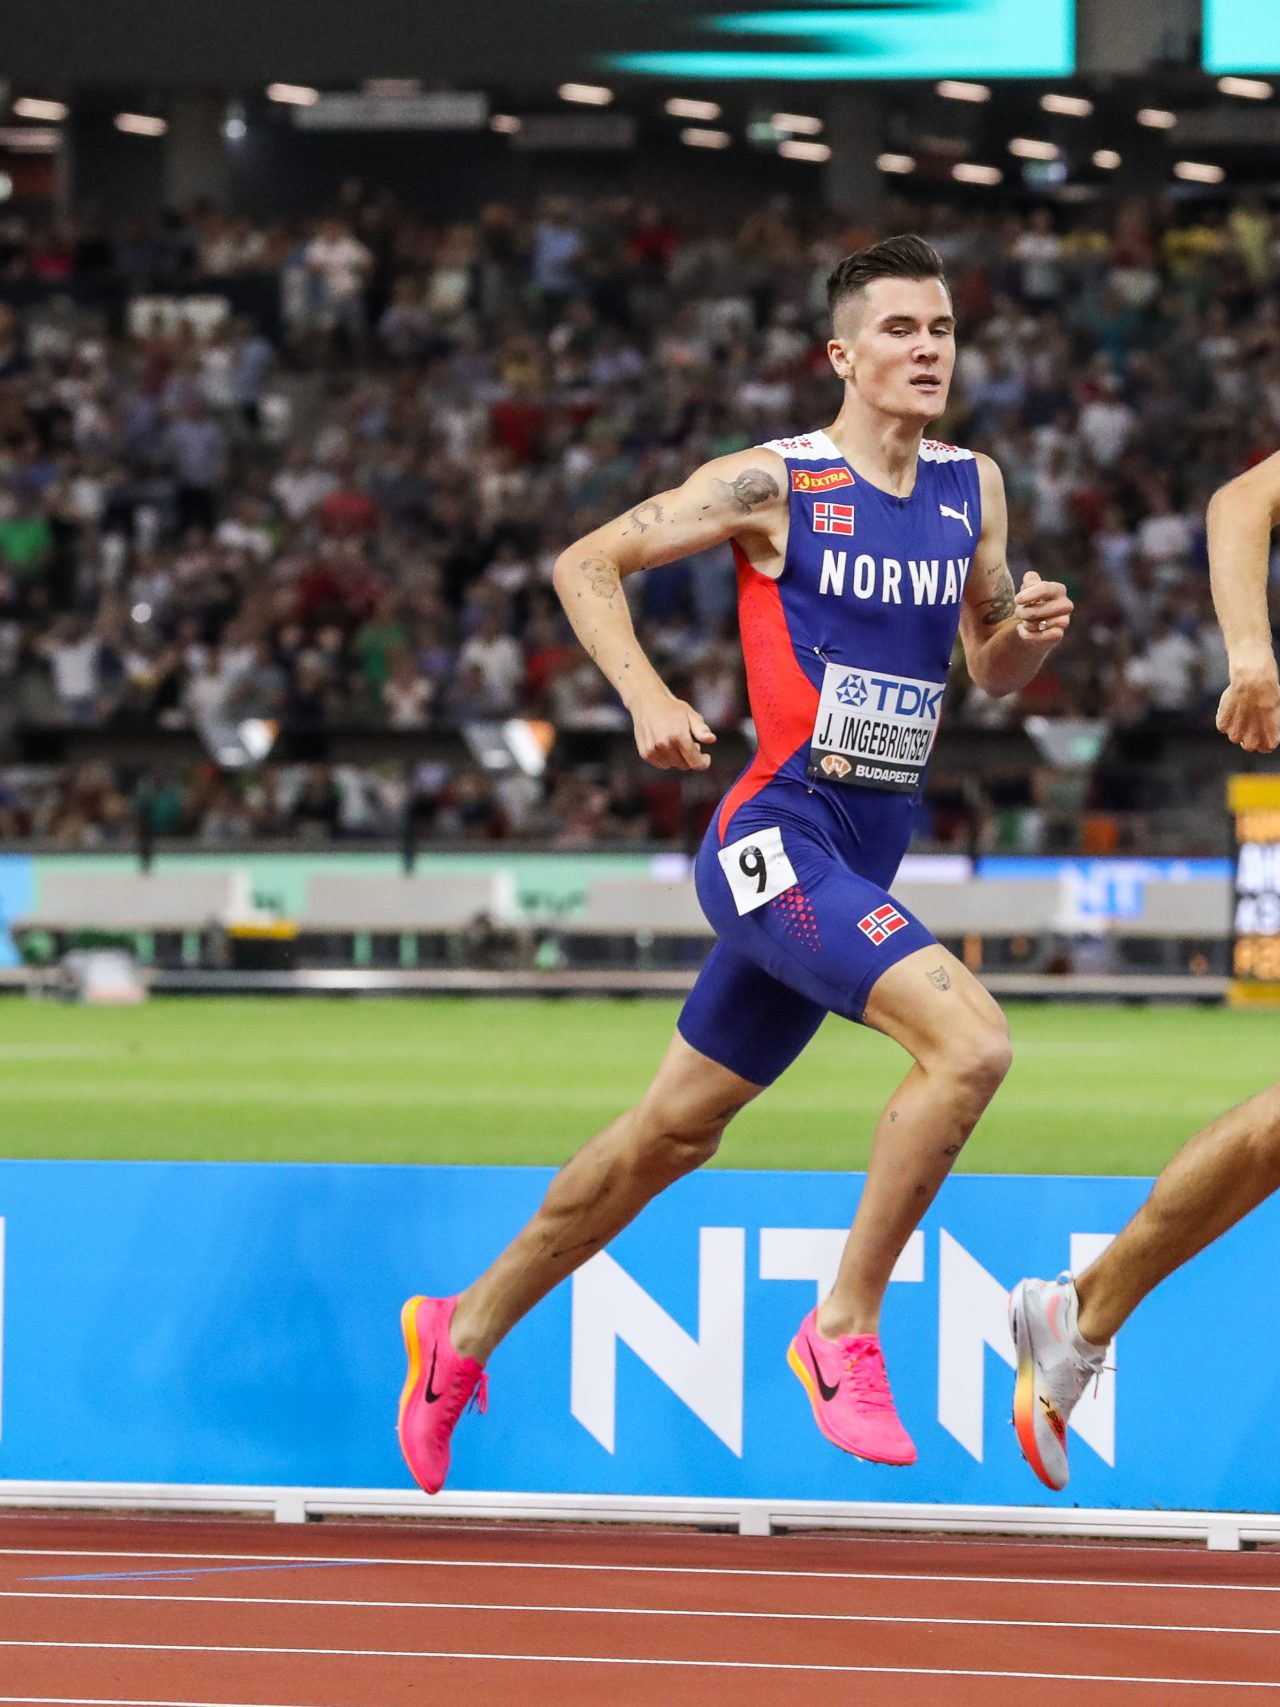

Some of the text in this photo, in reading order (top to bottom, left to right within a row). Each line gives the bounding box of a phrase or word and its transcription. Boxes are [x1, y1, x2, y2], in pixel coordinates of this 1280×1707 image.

[811, 472, 848, 487] EXTRA
[818, 549, 971, 606] NORWAY
[870, 678, 945, 720] TDK
[818, 712, 935, 762] J. INGEBRIGTSEN
[738, 845, 768, 894] 9
